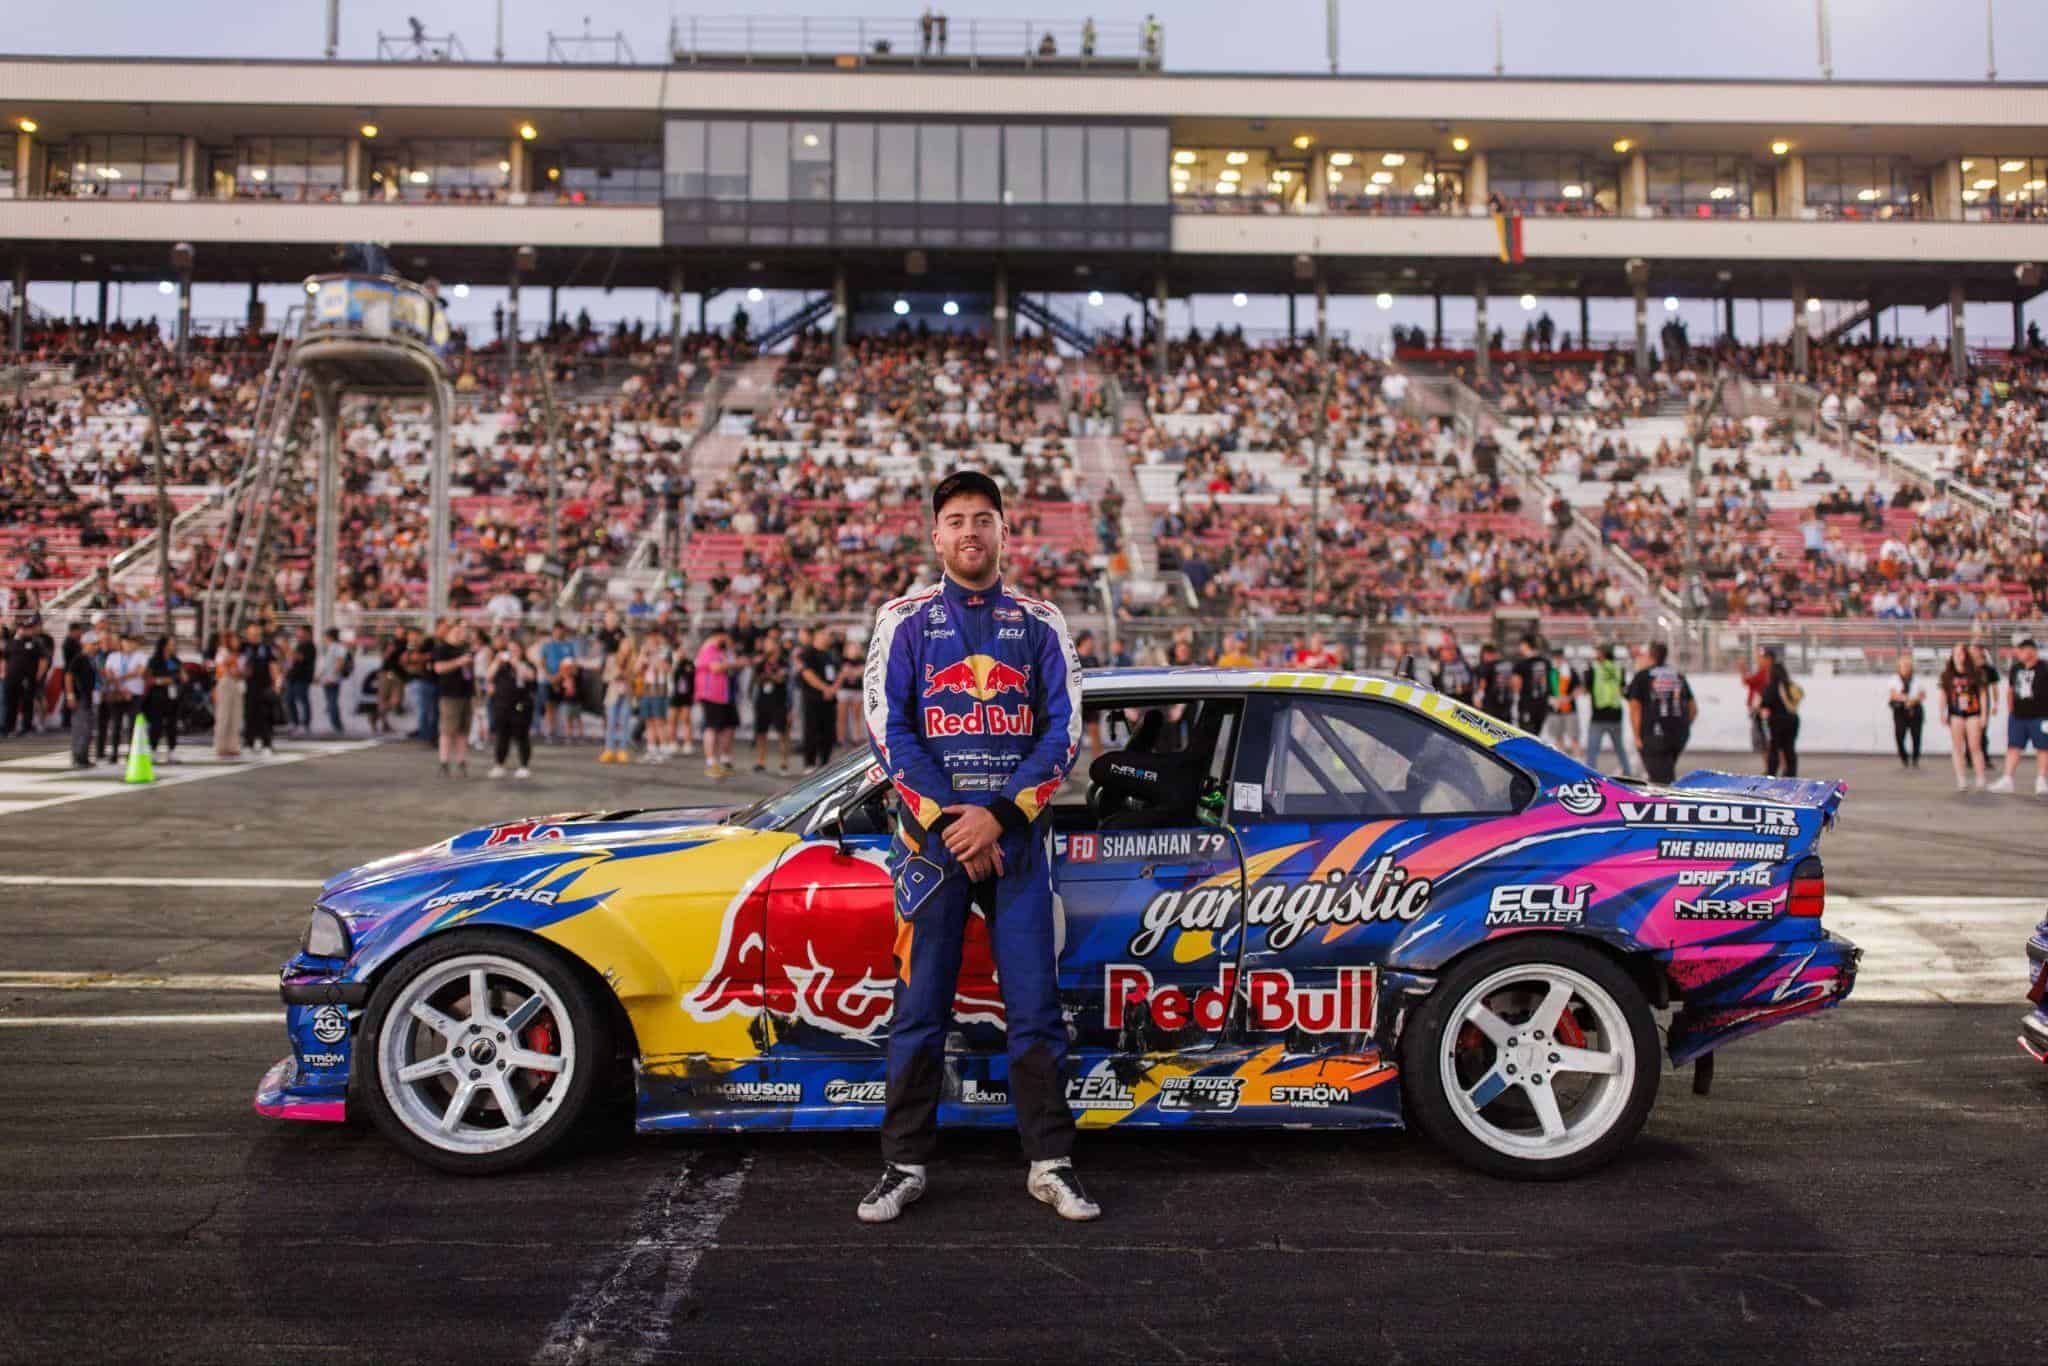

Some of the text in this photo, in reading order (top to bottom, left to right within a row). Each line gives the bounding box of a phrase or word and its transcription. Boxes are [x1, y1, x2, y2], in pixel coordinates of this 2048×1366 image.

[925, 702, 1034, 737] Red Bull
[1558, 784, 1602, 798] ACL
[1618, 803, 1797, 826] VITOUR
[1754, 824, 1800, 836] TIRES
[1071, 836, 1094, 859] FD
[1103, 834, 1191, 857] SHANAHAN
[1197, 834, 1226, 851] 79
[1661, 841, 1785, 859] THE SHANAHANS
[1129, 855, 1432, 956] garagistic
[1490, 884, 1592, 911] ECU
[1485, 911, 1584, 925] MASTER
[1105, 962, 1379, 1033] Red Bull
[313, 1018, 346, 1030] ACL
[1162, 1078, 1238, 1089] BIG DUCK
[1271, 1083, 1349, 1100] STRÖM
